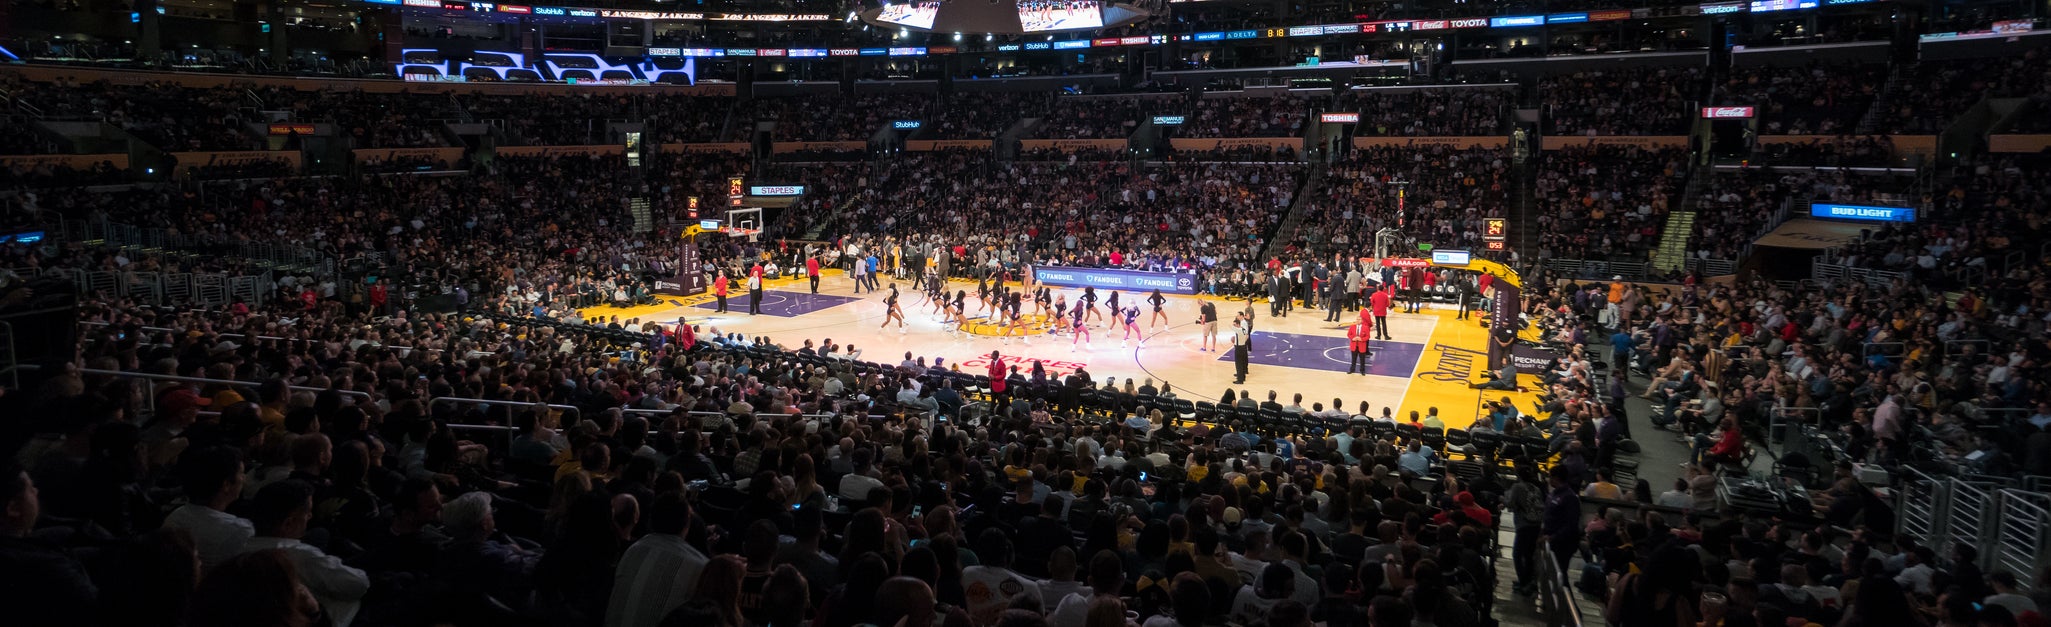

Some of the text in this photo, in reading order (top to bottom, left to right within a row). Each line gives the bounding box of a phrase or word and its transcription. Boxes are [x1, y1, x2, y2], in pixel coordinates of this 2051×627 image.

[535, 7, 564, 16] StubHub
[1703, 6, 1738, 14] verizon
[611, 11, 659, 20] ANGELES
[743, 14, 788, 22] ANGELES
[1450, 19, 1487, 27] TOYOTA
[1267, 28, 1285, 37] 8:18
[1715, 107, 1747, 117] Coca-Cola
[730, 185, 742, 195] 24
[761, 187, 795, 195] STAPLES
[1831, 207, 1893, 218] BUD LIGHT
[1488, 226, 1501, 235] 24
[1046, 274, 1074, 282] FANDUEL
[1093, 276, 1123, 285] FANDUEL
[1143, 279, 1174, 288] FANDUEL
[1514, 356, 1552, 365] PECHAN
